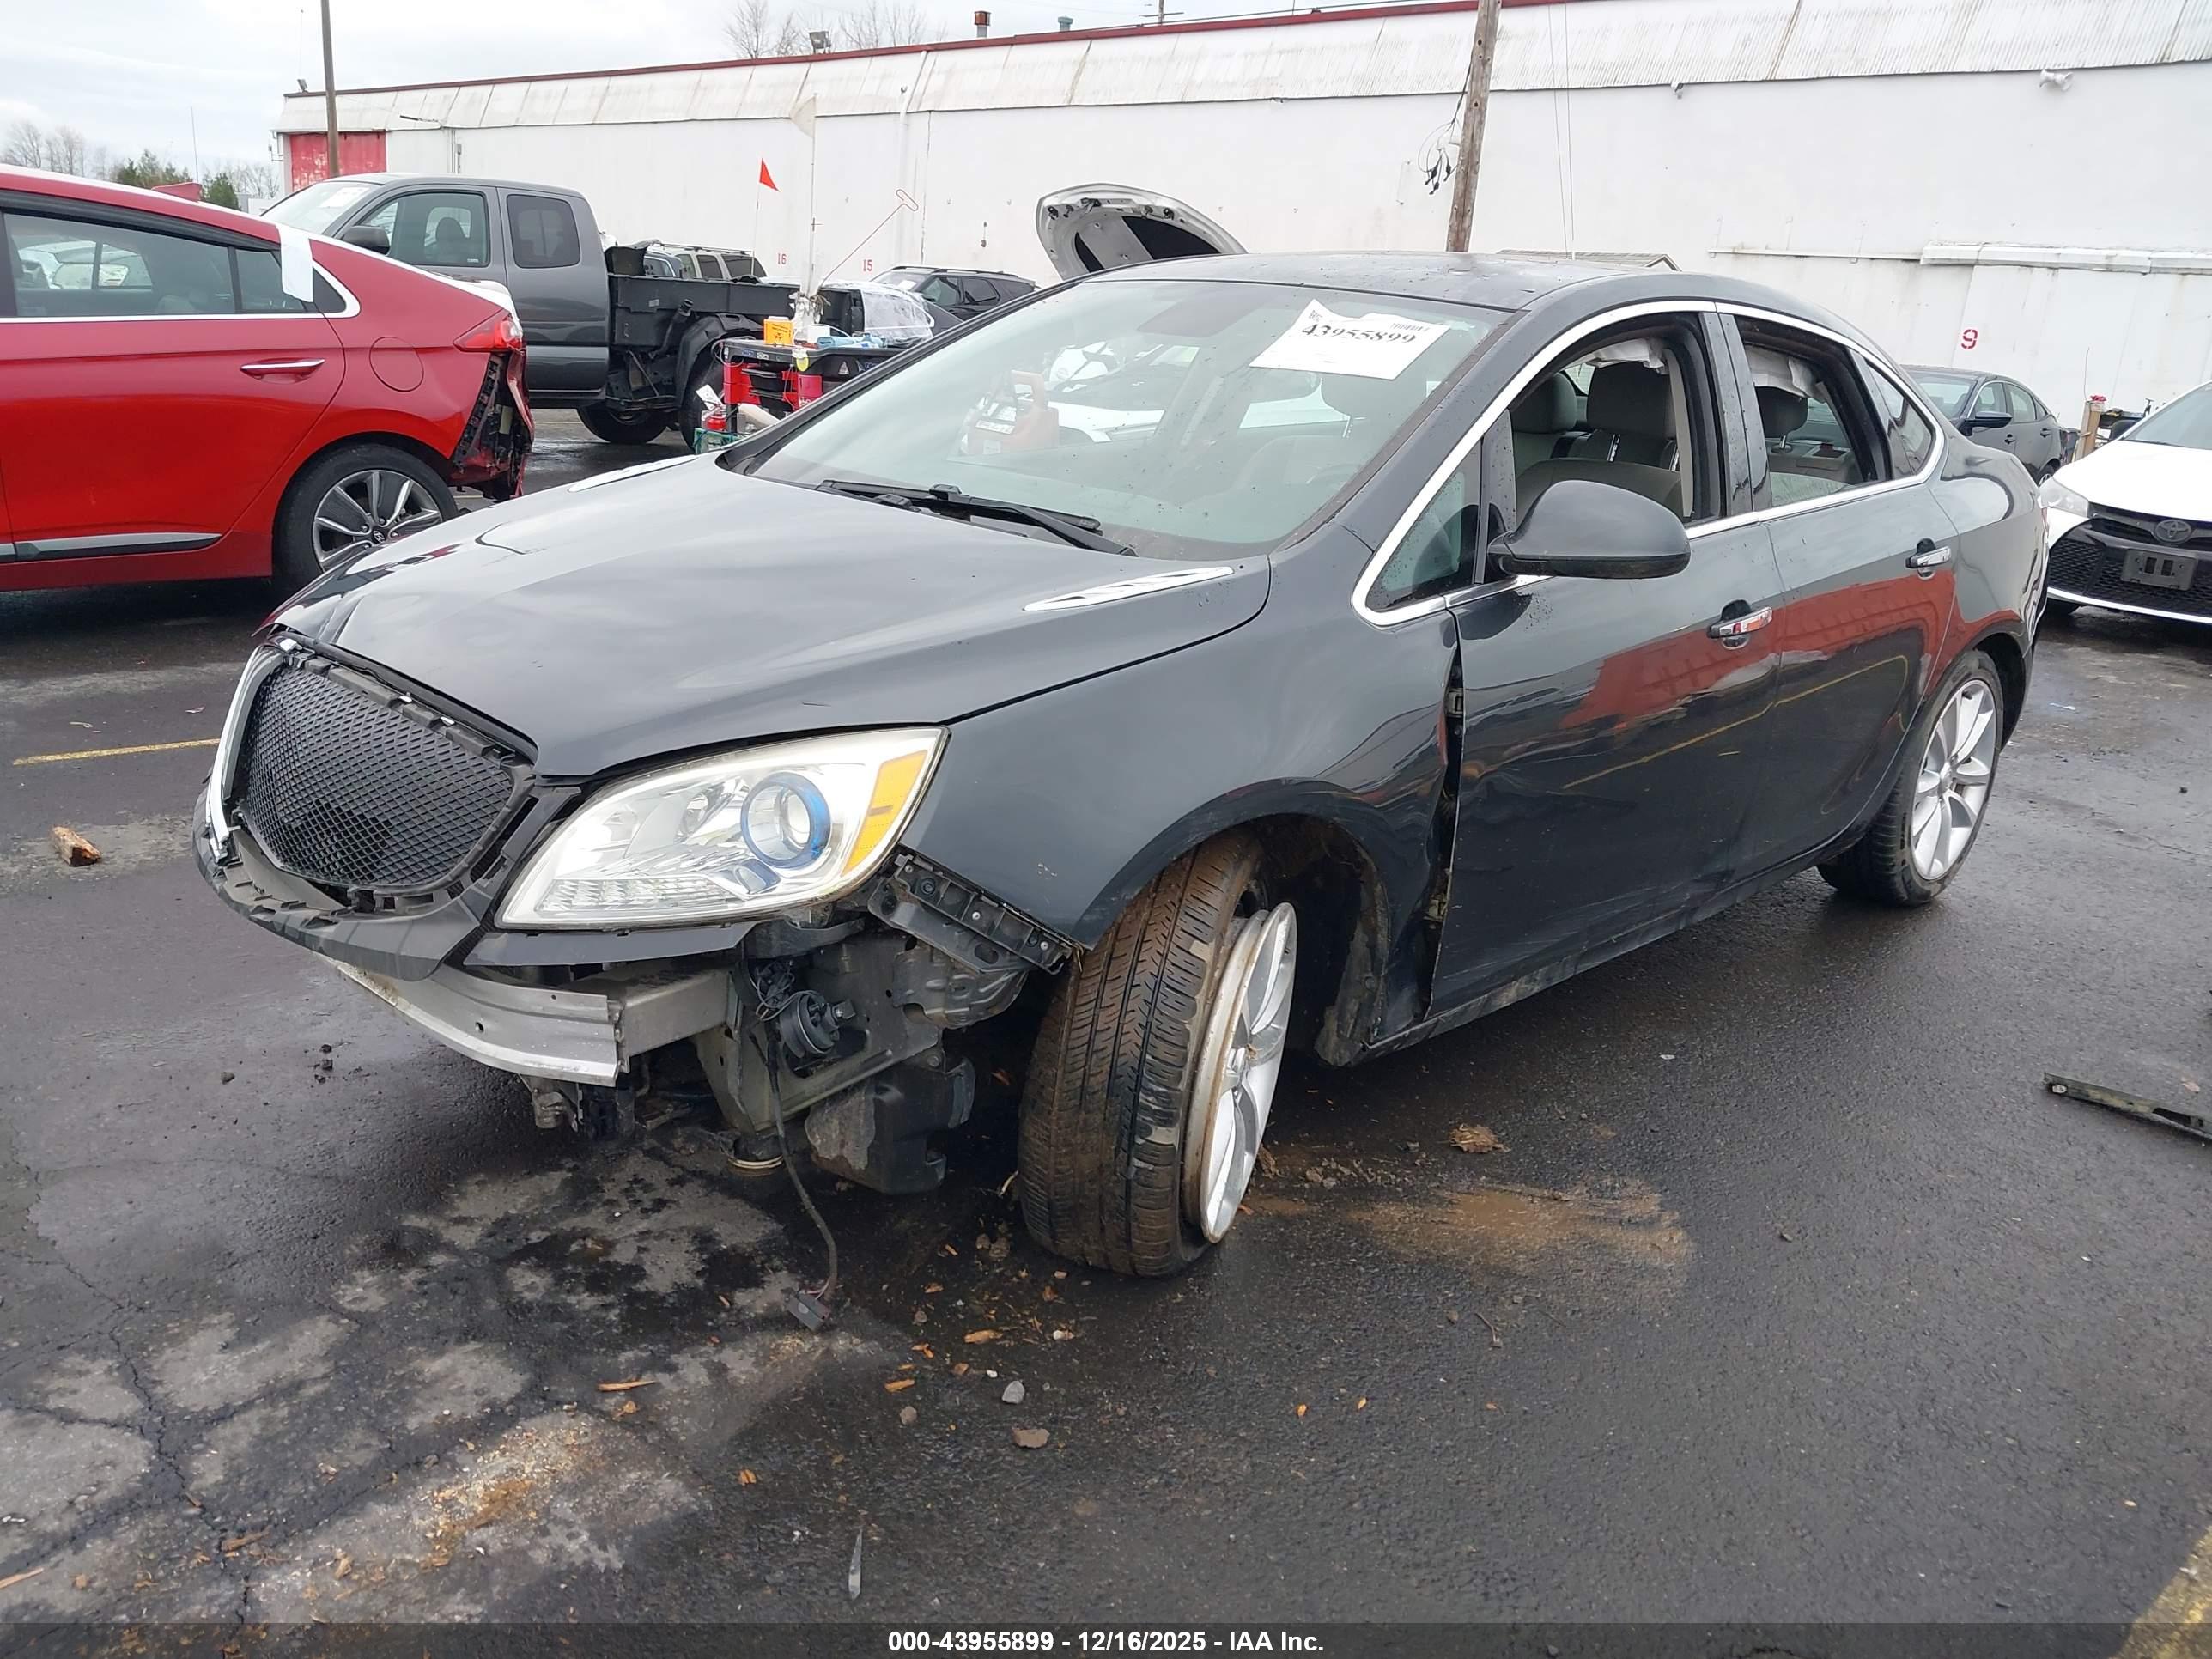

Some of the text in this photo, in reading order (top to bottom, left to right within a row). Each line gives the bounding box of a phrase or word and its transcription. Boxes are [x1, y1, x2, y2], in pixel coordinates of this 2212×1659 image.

[777, 253, 787, 265] 16
[863, 259, 873, 272] 15
[1302, 323, 1417, 343] 43955899
[1961, 329, 1978, 349] 9
